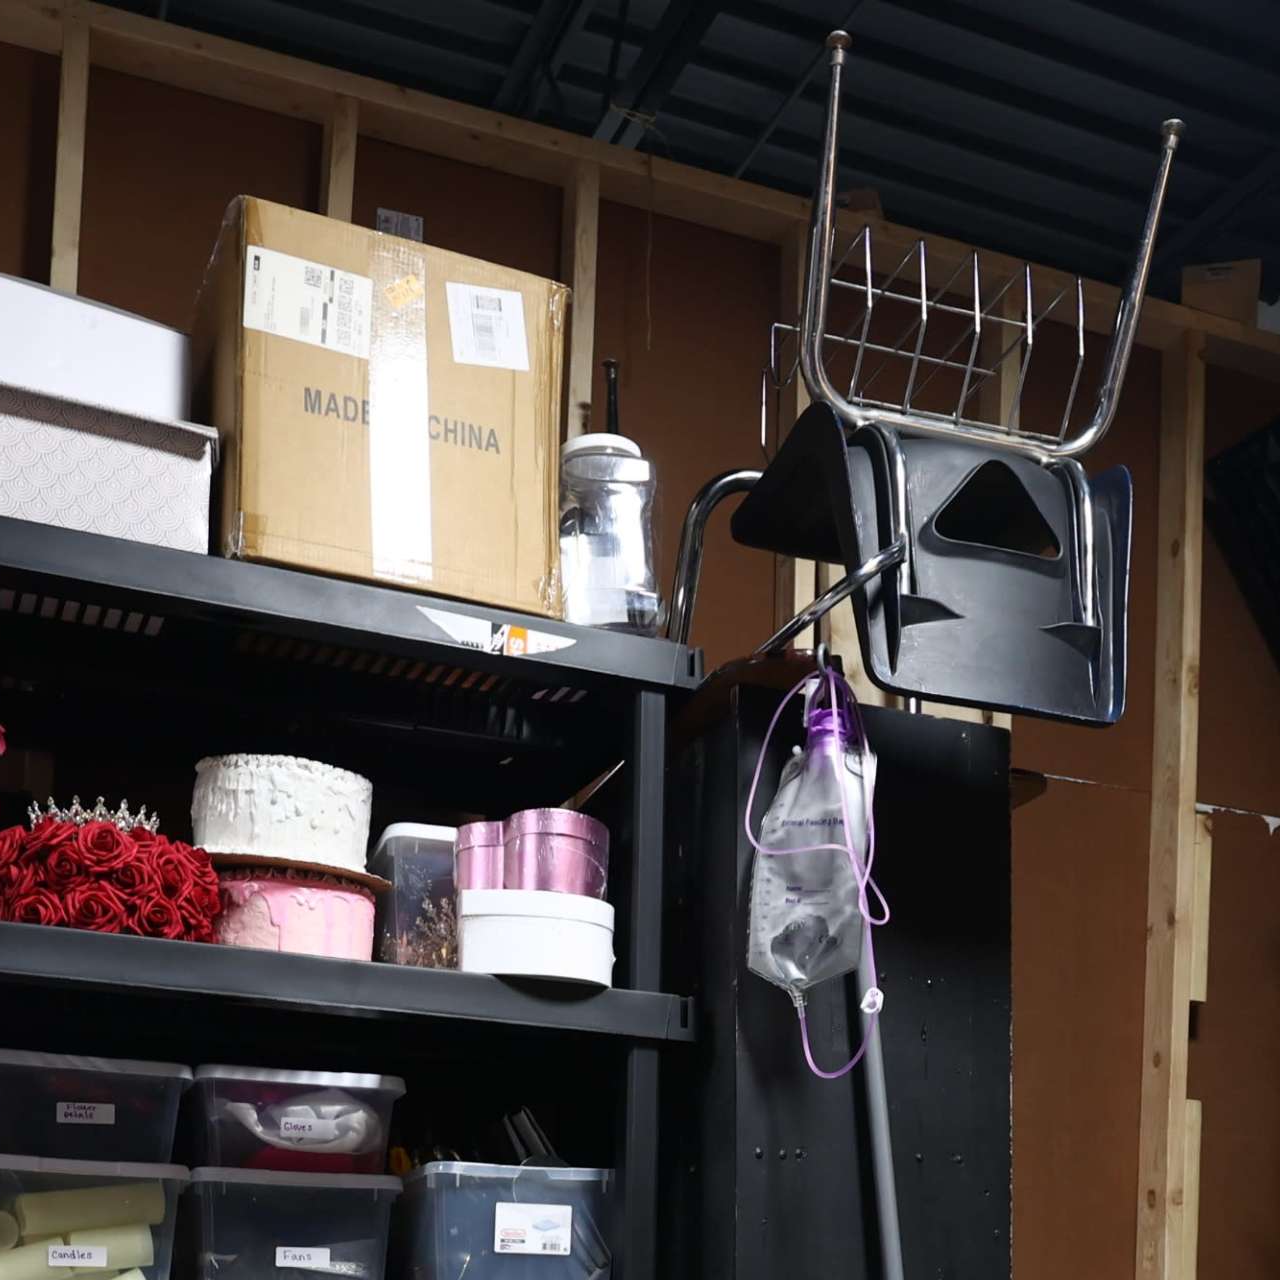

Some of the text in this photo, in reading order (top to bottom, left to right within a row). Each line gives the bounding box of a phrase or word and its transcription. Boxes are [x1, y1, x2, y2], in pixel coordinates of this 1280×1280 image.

[304, 386, 501, 455] MADE CHINA
[284, 1121, 314, 1132] Gloves
[51, 1249, 93, 1260] Candles
[282, 1249, 312, 1262] Fans
